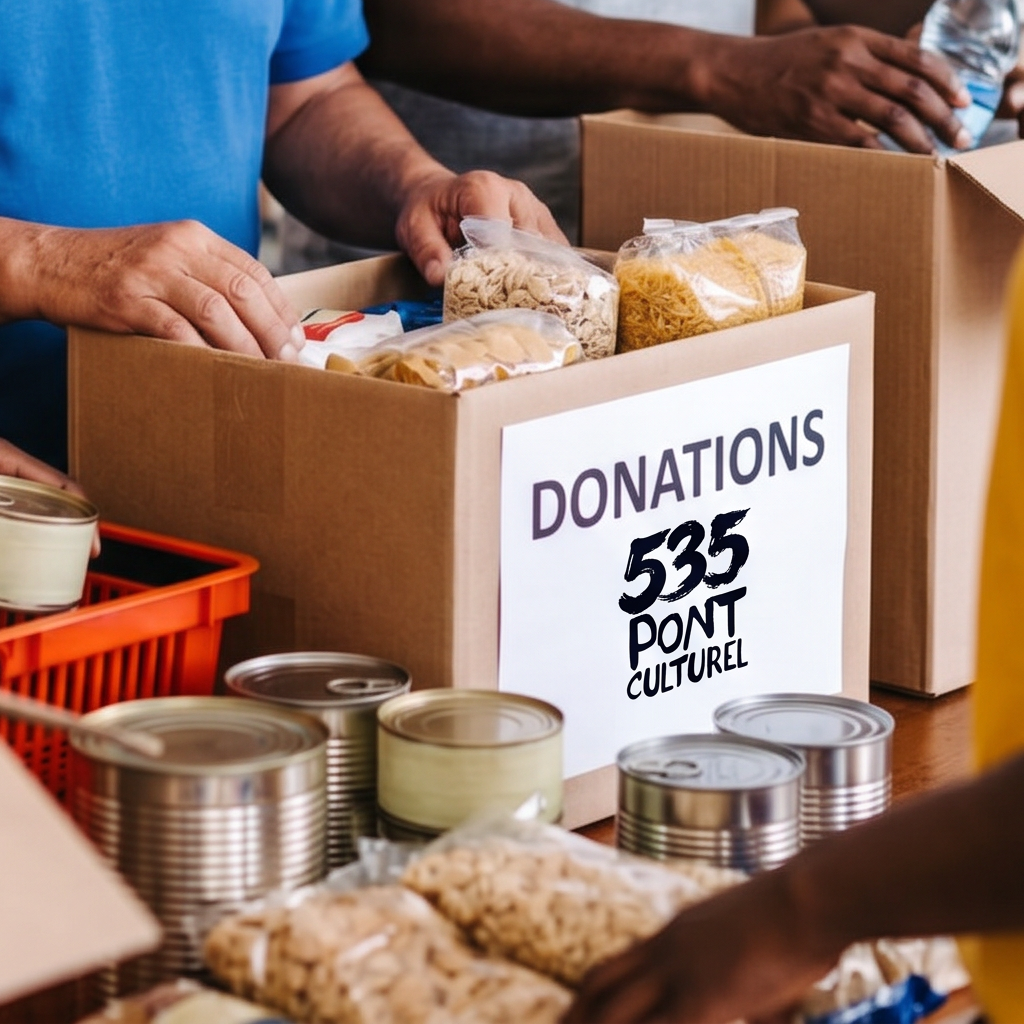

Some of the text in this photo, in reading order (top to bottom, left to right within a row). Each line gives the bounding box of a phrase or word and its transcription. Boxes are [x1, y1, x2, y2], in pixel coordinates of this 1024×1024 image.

[532, 409, 825, 540] DONATIONS
[619, 507, 751, 615] 535
[626, 638, 749, 700] CULTUREL
[628, 586, 747, 671] PONT
